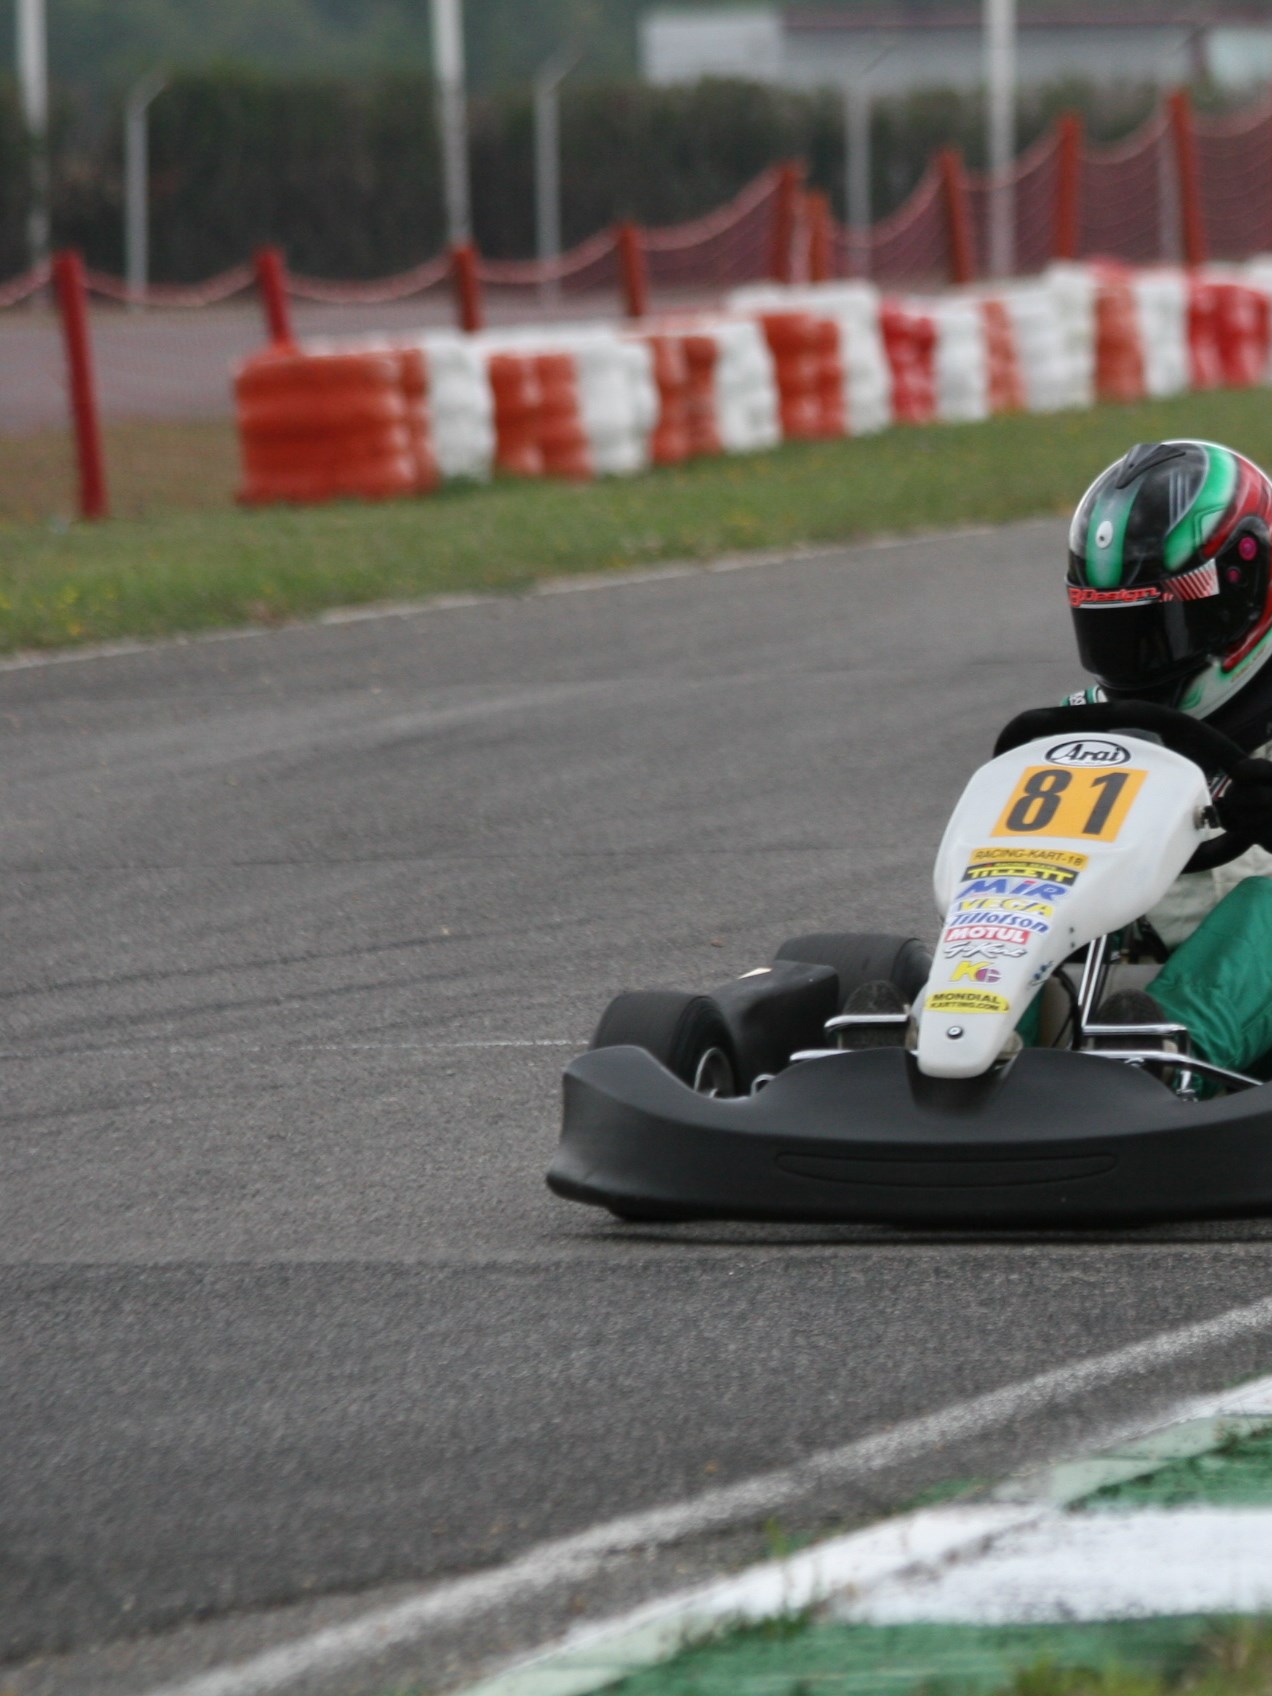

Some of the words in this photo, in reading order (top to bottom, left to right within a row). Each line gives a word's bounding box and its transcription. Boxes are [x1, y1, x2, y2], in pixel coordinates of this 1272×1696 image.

[1057, 743, 1127, 765] Arai
[1006, 768, 1130, 835] 81
[966, 866, 1074, 882] TILLETT
[956, 898, 1054, 917] VEGA
[946, 926, 1024, 942] MOTUL
[932, 992, 1001, 1005] MONDIAL
